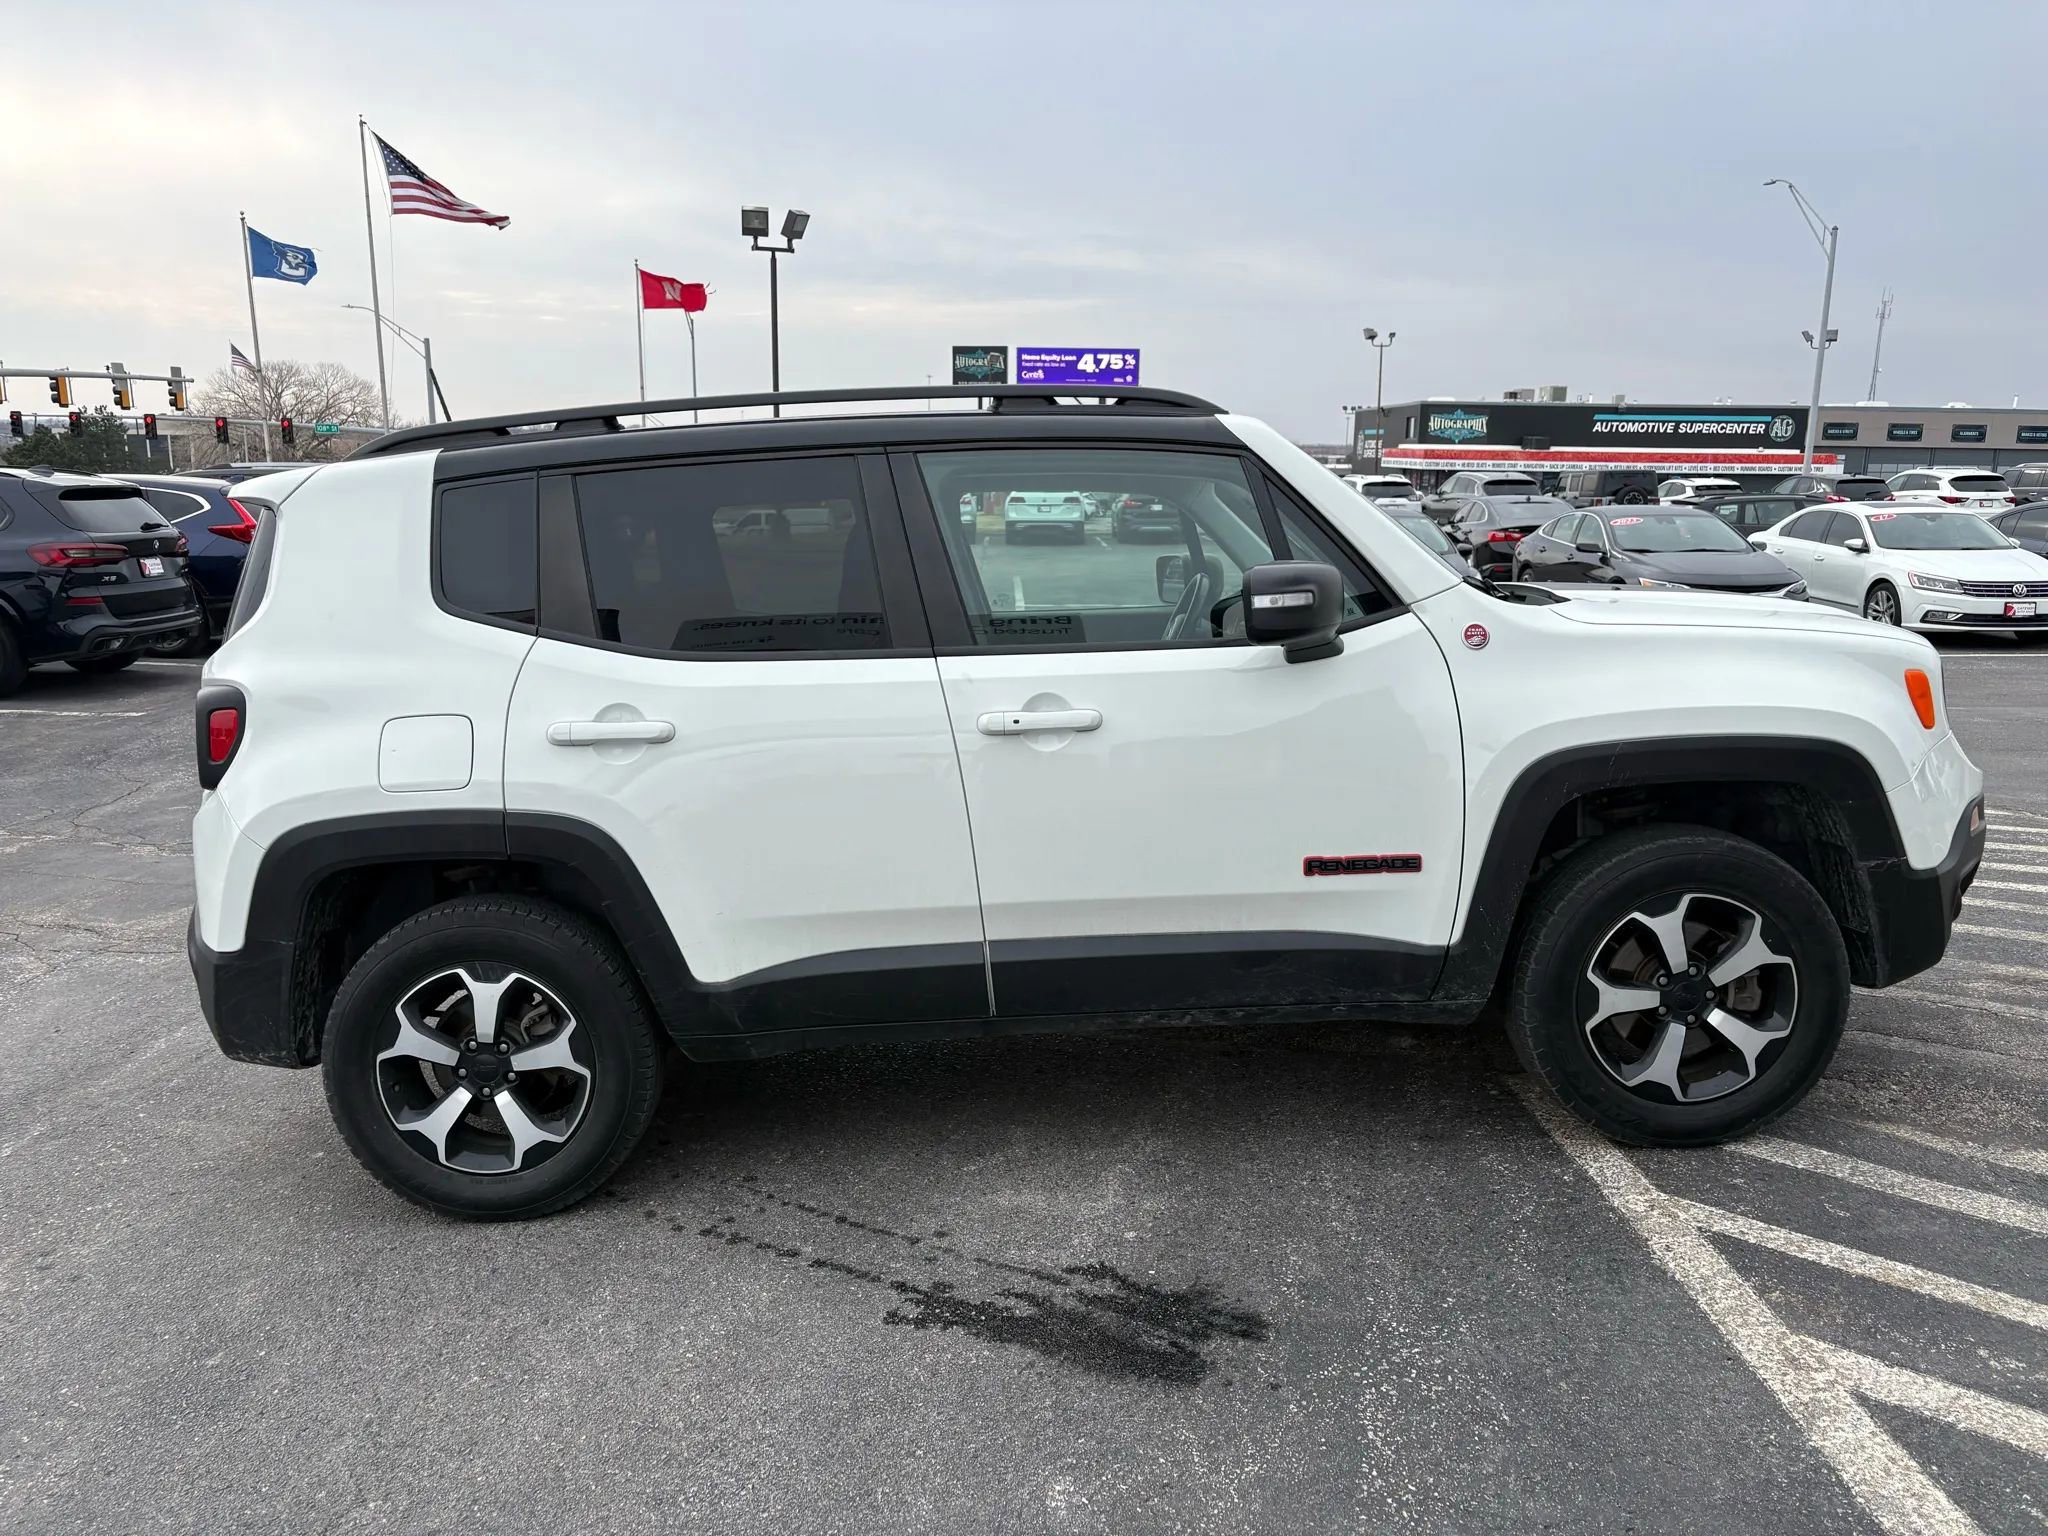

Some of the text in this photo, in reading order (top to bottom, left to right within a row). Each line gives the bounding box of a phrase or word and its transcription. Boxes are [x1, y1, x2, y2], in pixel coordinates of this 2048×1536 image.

[1593, 421, 1765, 434] AUTOMOTIVE SUPERCENTER
[1305, 856, 1421, 874] RENEGADE
